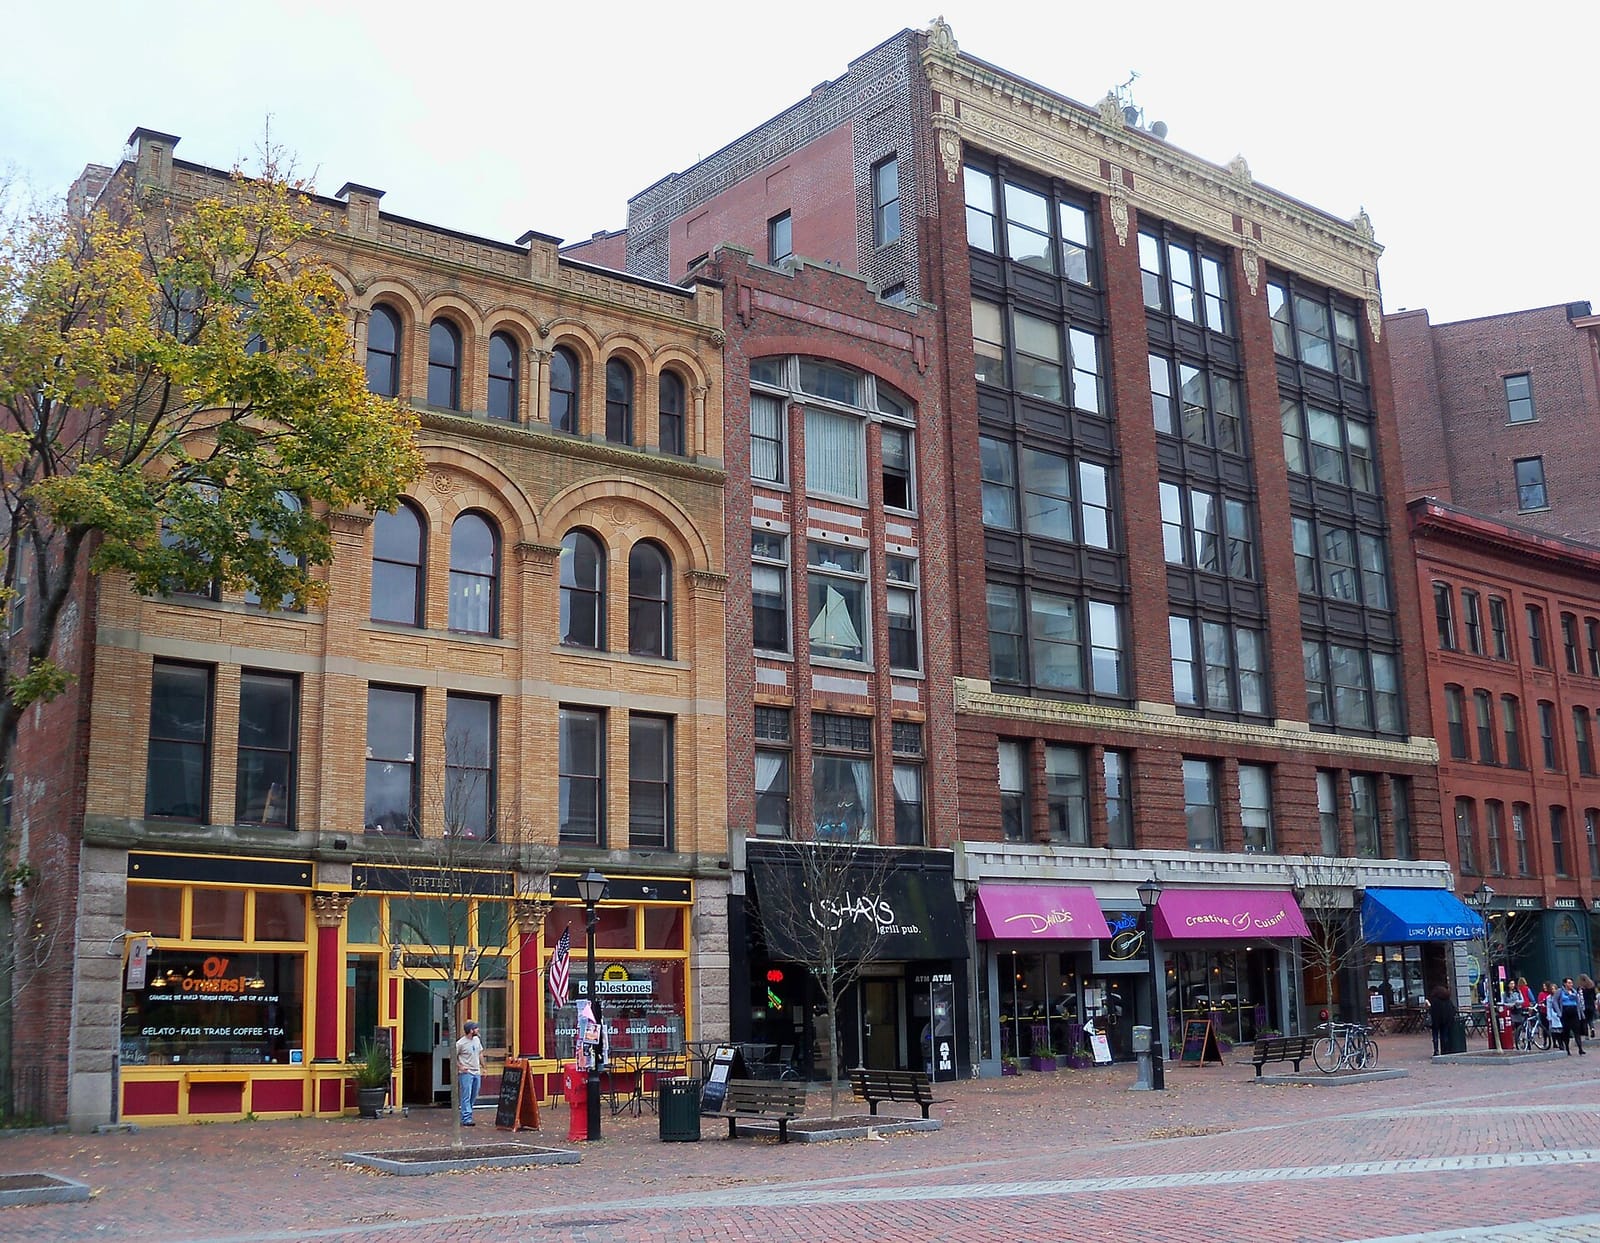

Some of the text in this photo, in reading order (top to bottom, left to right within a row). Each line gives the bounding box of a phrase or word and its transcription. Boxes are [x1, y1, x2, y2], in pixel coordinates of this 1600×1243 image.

[1185, 910, 1286, 928] Creative Cuisine
[880, 924, 922, 935] grill pub.
[1427, 924, 1454, 938] SPARTAN
[1454, 924, 1471, 937] GRILL
[931, 974, 952, 983] ATM
[579, 982, 652, 993] cbblestones
[203, 1027, 231, 1036] TRADE
[625, 1024, 677, 1035] sandwiches
[939, 1042, 952, 1070] ATM
